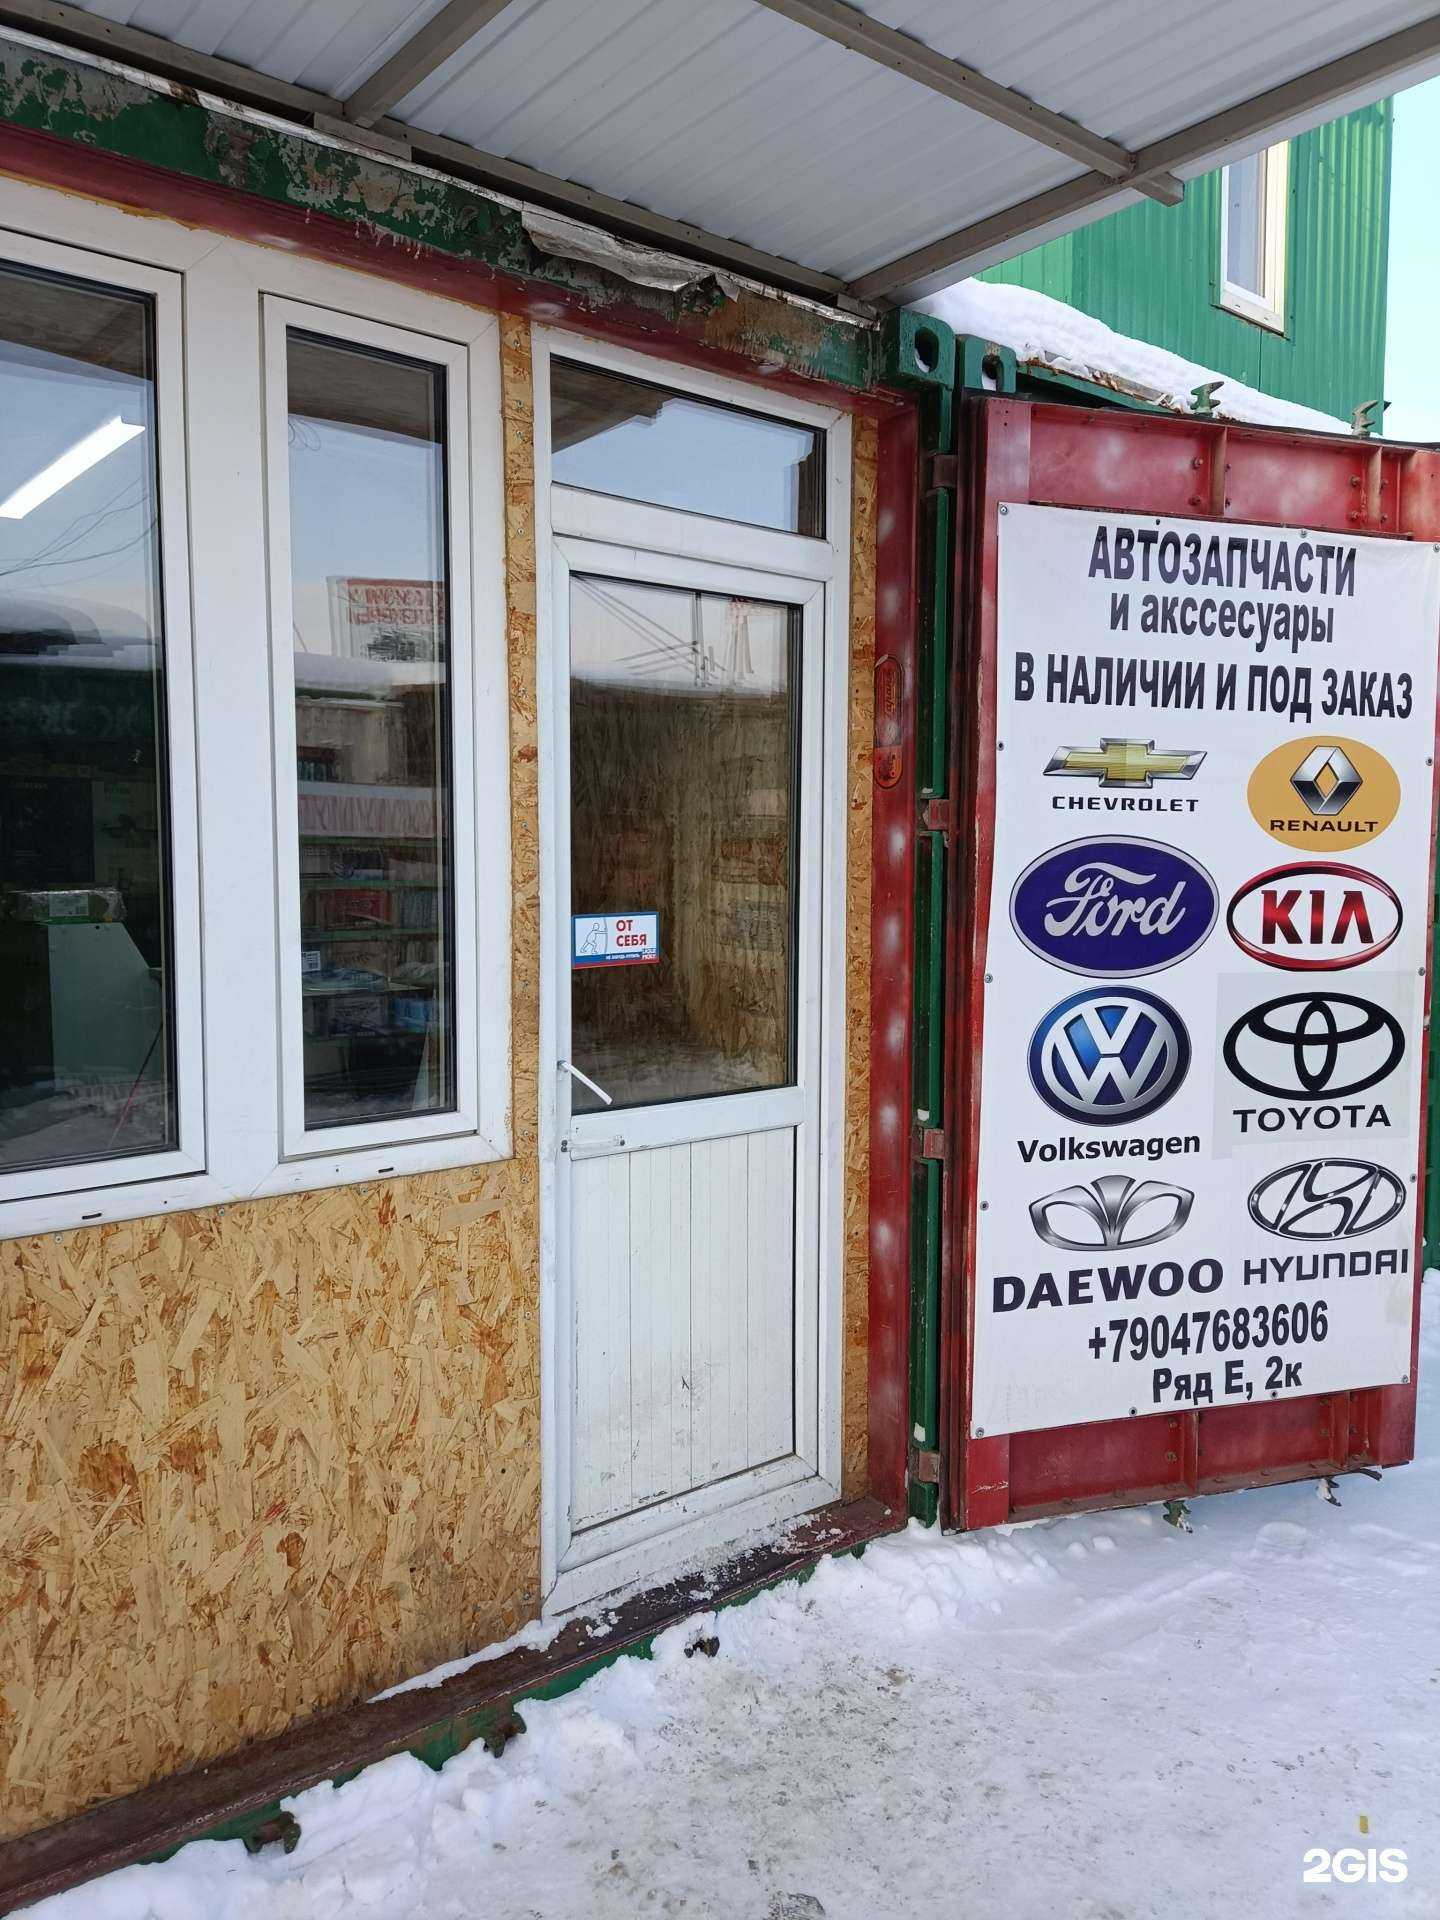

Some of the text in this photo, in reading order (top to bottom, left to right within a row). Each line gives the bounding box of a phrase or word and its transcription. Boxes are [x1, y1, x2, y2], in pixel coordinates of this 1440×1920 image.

[1087, 525, 1357, 597] АВТОЗАПЧАСТИ
[1109, 592, 1334, 653] и акссесуары
[1014, 651, 1414, 723] В НАЛИЧИИ И ПОД ЗАКАЗ
[1051, 795, 1199, 813] CHEVROLET
[1269, 819, 1379, 833] RENAULT
[1043, 862, 1187, 937] Ford
[1261, 889, 1374, 945] KIA
[616, 919, 633, 932] ОТ
[616, 933, 647, 947] СЕБЯ
[1233, 1104, 1391, 1133] TOYOTA
[1017, 1134, 1201, 1163] Volkswagen
[992, 1257, 1224, 1313] DAEWOO
[1243, 1248, 1408, 1286] HYUNDAI
[1088, 1300, 1329, 1362] +79047683606
[1152, 1355, 1303, 1405] Ряд Е, 2к
